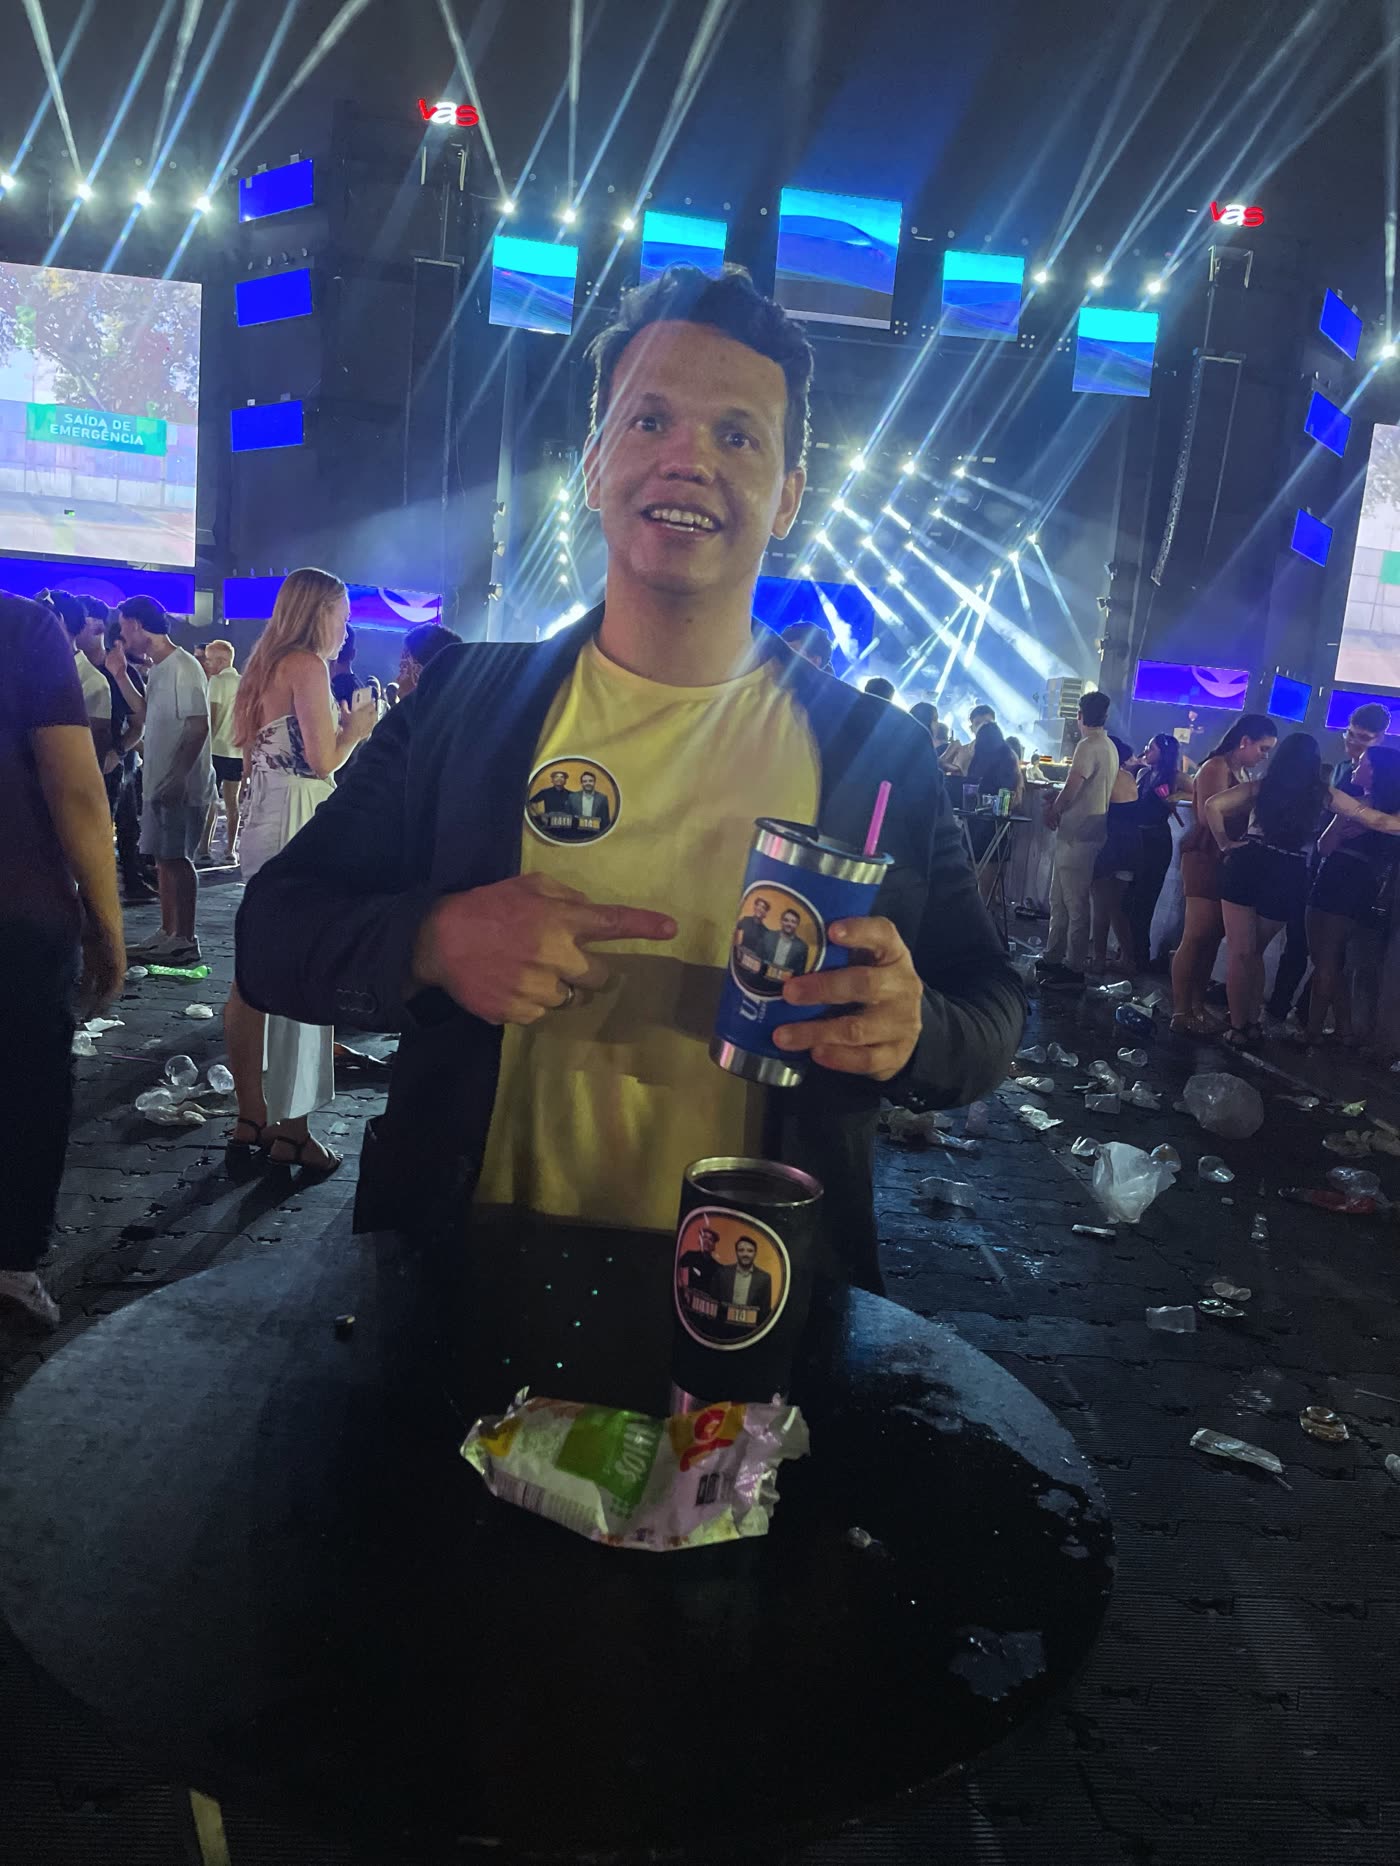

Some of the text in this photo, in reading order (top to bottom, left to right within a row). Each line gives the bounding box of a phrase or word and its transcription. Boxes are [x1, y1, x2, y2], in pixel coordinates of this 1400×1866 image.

[418, 98, 480, 127] vas
[1209, 201, 1265, 228] vas
[63, 413, 132, 432] SAÍDA DE
[49, 424, 144, 446] EMERGÊNCIA
